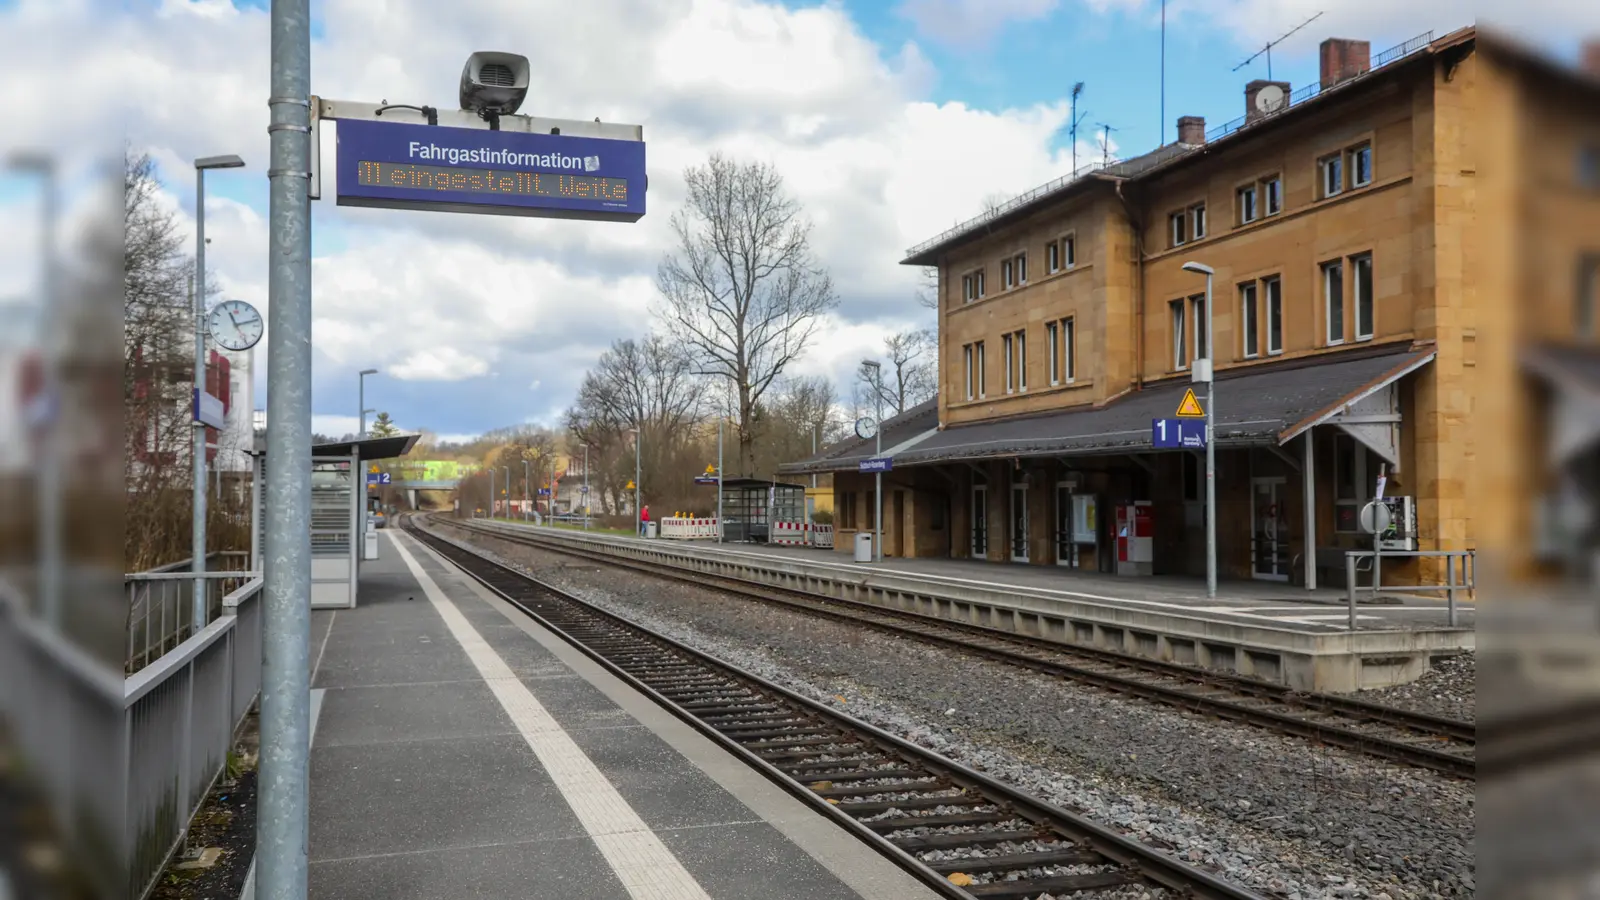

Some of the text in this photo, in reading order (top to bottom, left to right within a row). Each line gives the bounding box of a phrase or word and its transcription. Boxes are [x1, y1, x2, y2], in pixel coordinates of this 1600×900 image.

[409, 141, 582, 169] Fahrgastinformation
[391, 165, 549, 194] eingestellt.
[1157, 419, 1166, 441] 1
[383, 472, 390, 483] 2
